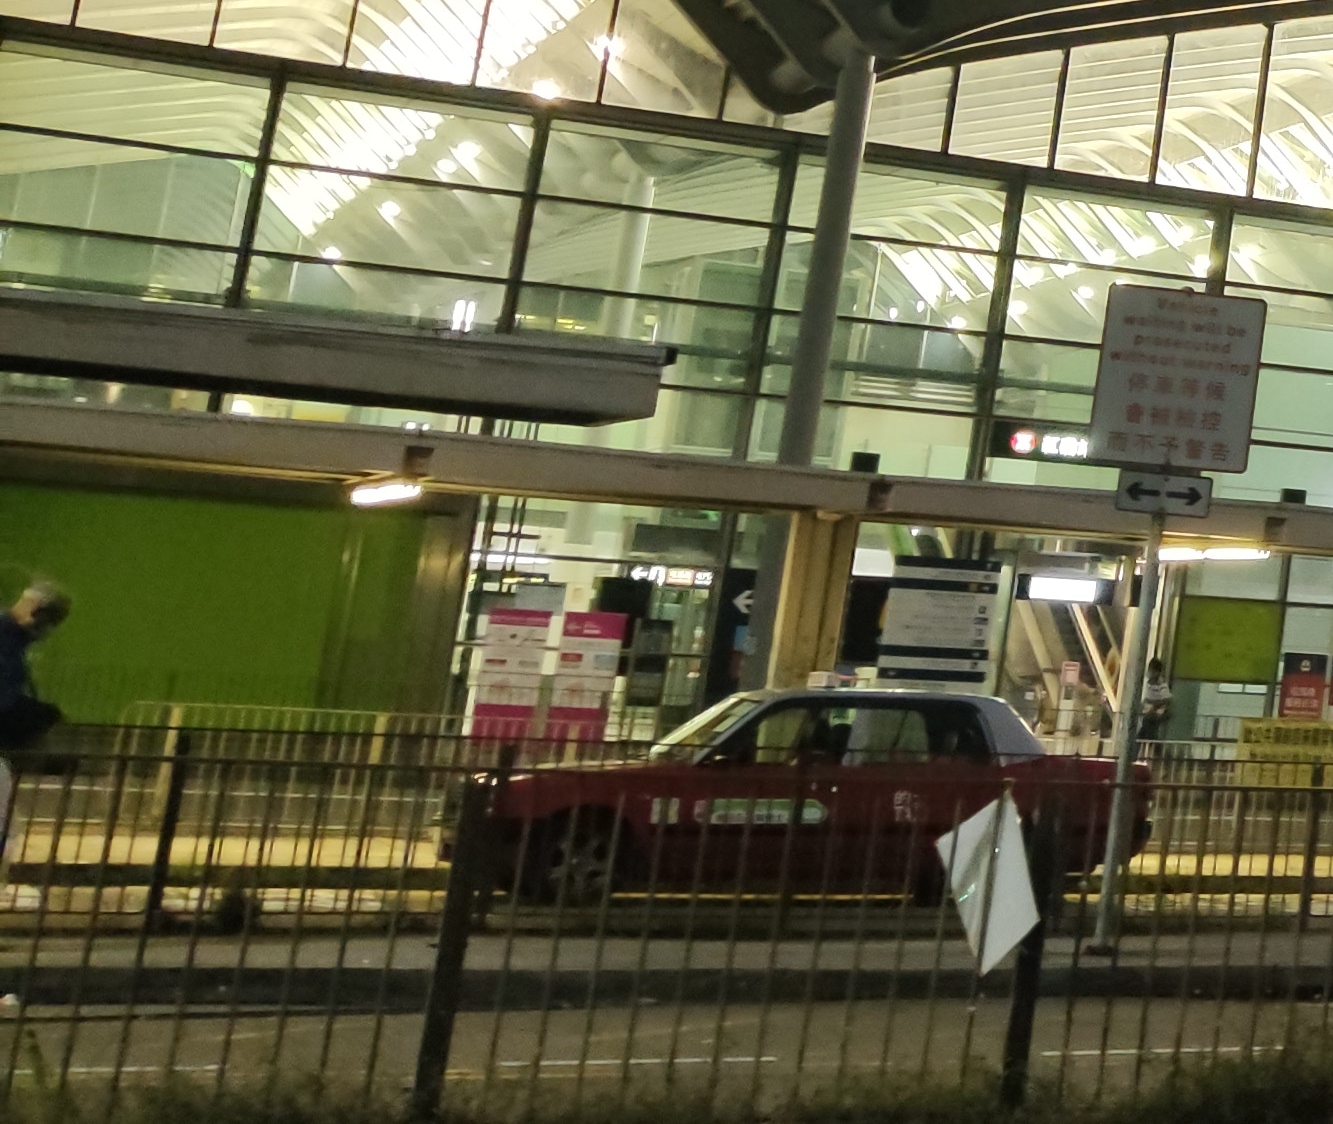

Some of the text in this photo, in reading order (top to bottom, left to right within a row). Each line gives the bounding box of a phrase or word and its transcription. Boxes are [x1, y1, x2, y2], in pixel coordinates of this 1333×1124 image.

[1157, 297, 1219, 317] Vehicle
[1123, 314, 1187, 333] waiting
[1226, 325, 1248, 338] be
[1133, 334, 1232, 355] prosecuted
[1181, 359, 1251, 377] warning
